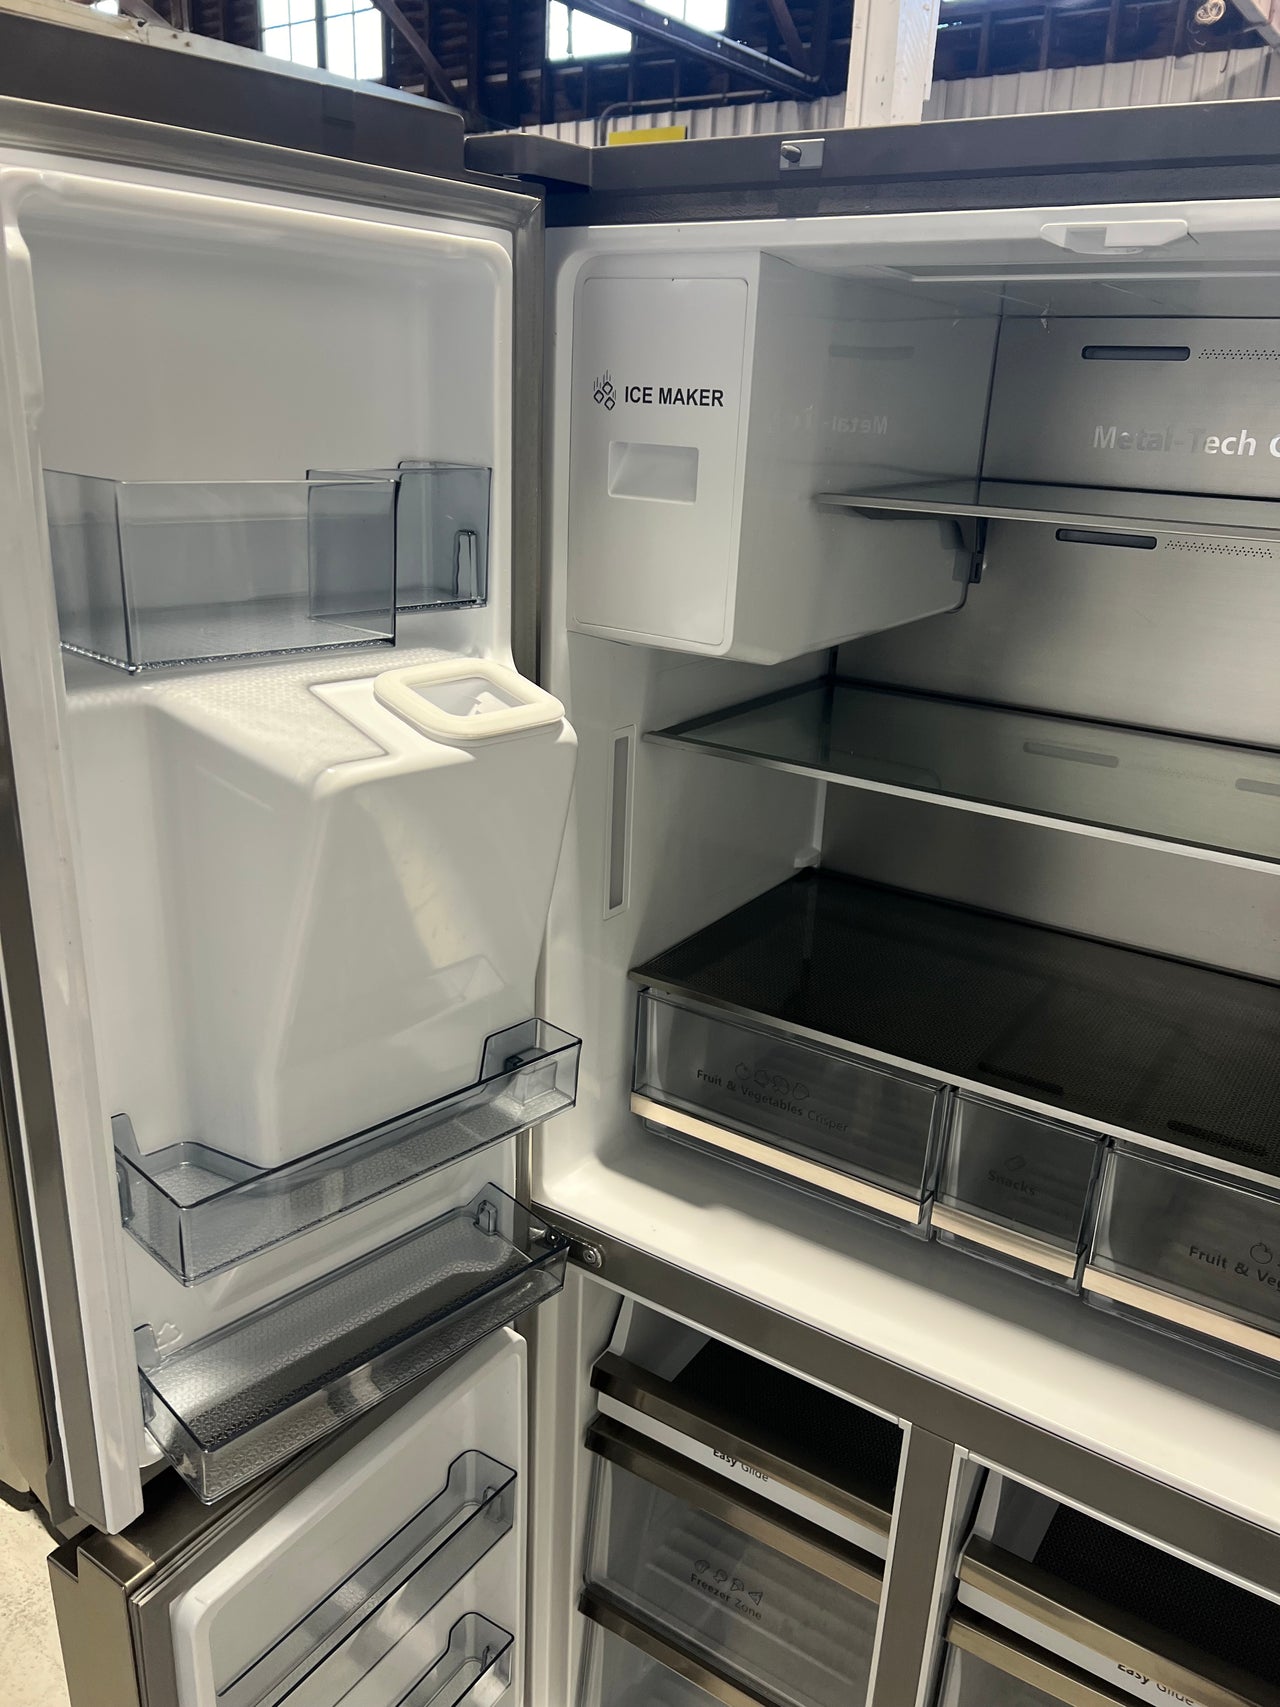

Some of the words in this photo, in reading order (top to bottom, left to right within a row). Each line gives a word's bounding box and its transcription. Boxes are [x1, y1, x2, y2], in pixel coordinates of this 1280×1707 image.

[624, 386, 653, 404] ICE
[658, 387, 724, 407] MAKER
[1093, 425, 1257, 456] Metal-Tech
[697, 1069, 722, 1086] Fruit
[727, 1080, 736, 1092] &
[740, 1085, 803, 1116] Vegetables
[807, 1110, 848, 1132] Crisper
[988, 1169, 1035, 1196] Snacks
[1189, 1245, 1227, 1269] Fruit
[1234, 1262, 1249, 1277] &
[713, 1449, 737, 1467] Easy
[691, 1573, 732, 1601] Freezer
[735, 1599, 762, 1620] Zone
